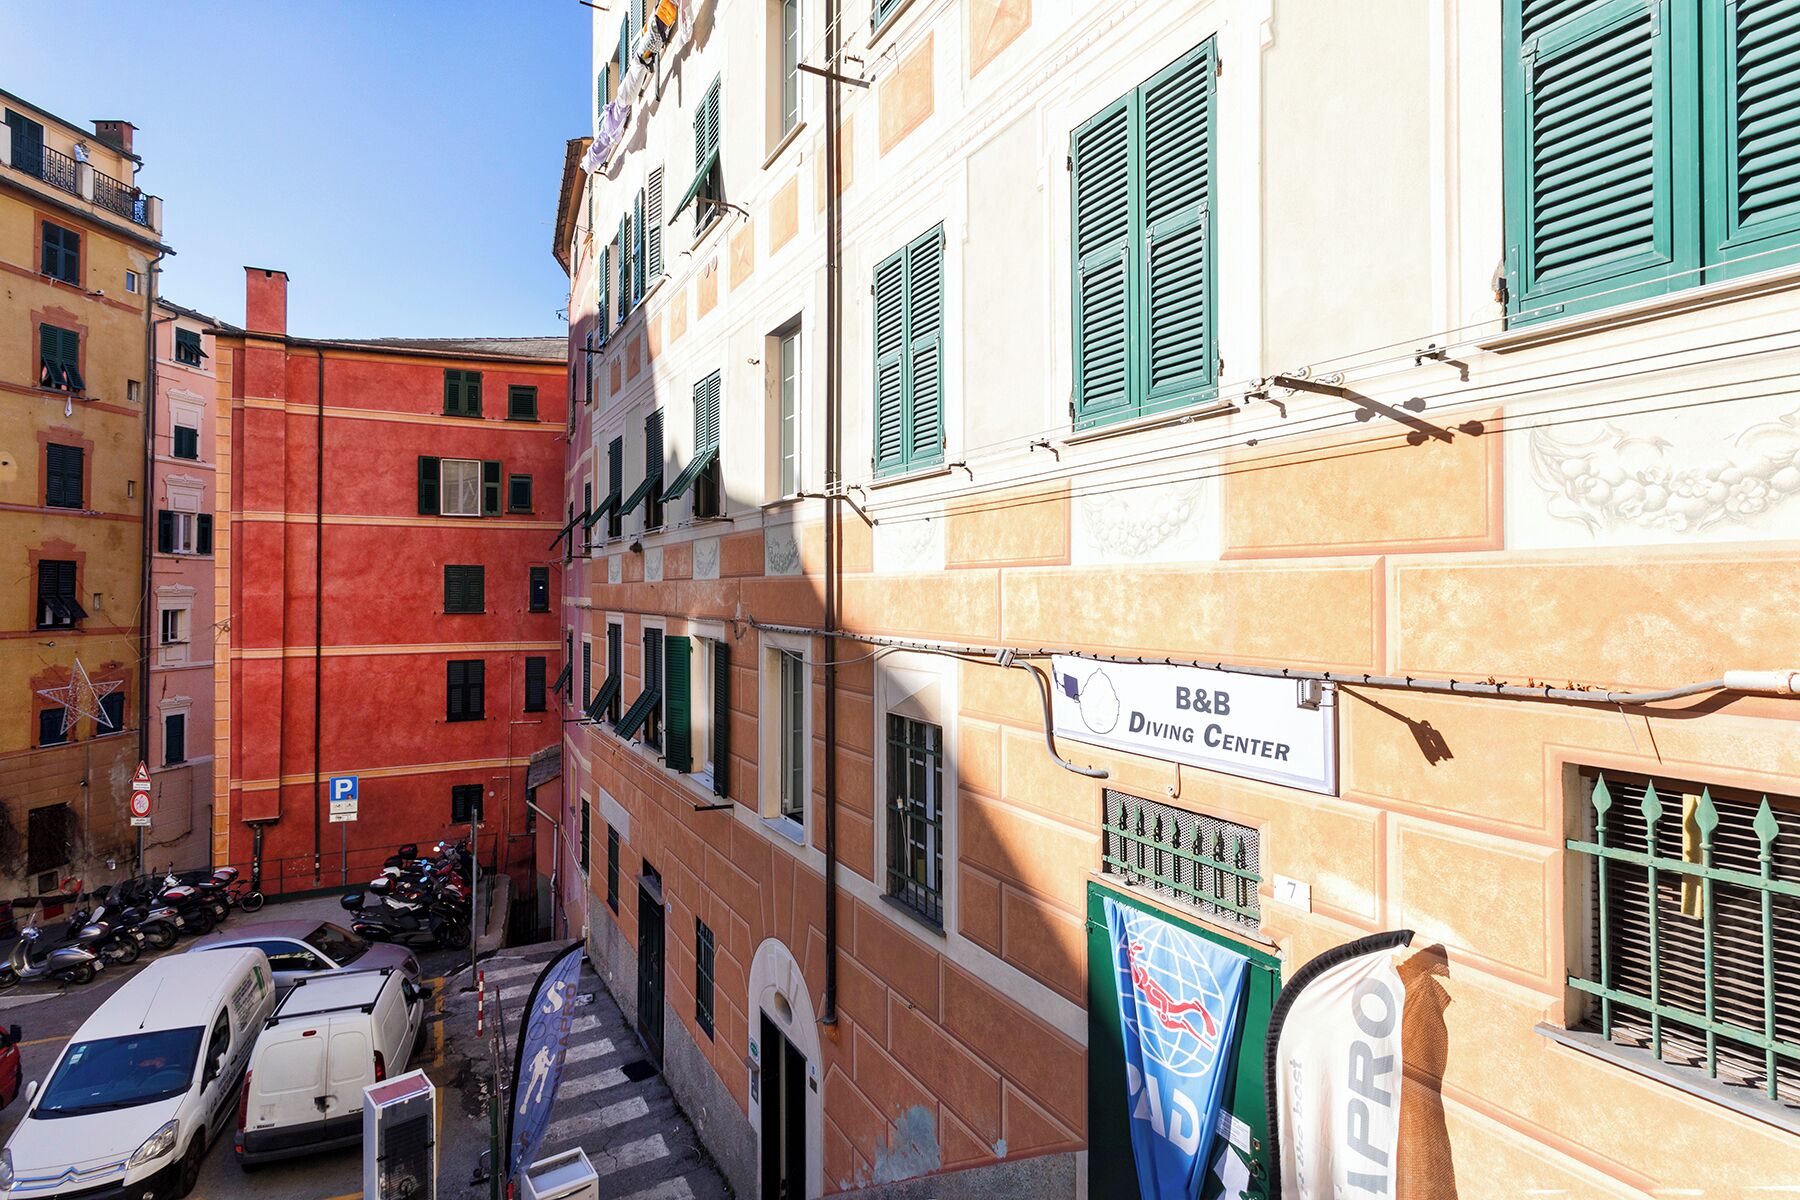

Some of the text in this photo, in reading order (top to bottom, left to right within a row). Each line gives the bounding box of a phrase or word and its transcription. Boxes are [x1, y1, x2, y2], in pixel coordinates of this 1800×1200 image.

[1176, 686, 1231, 716] B&B
[1129, 711, 1290, 761] DIVING CENTER
[335, 779, 353, 800] P
[1287, 881, 1296, 899] 7
